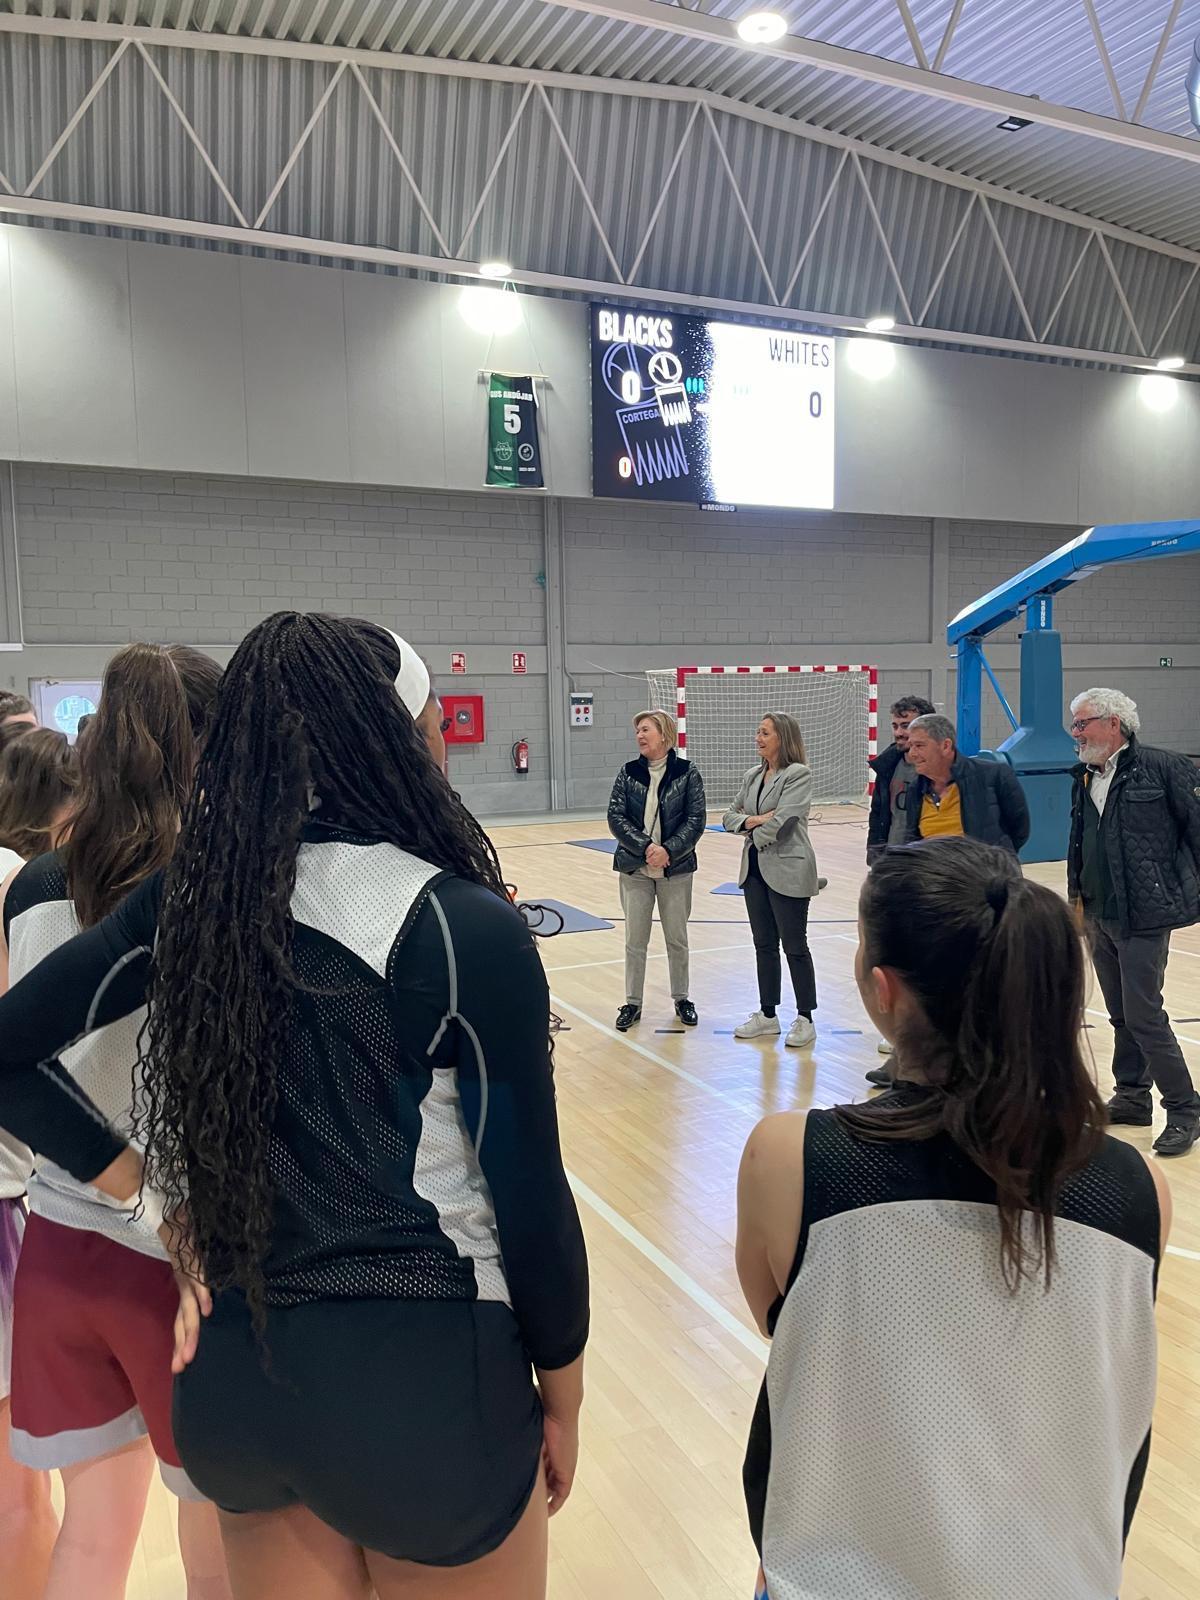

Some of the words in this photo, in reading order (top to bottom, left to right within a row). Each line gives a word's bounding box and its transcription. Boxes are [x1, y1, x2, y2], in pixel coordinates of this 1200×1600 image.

[599, 310, 673, 348] BLACKS
[769, 337, 829, 367] WHITES
[622, 370, 641, 404] 0
[503, 404, 521, 434] 5
[809, 391, 821, 418] 0
[618, 456, 631, 478] 0
